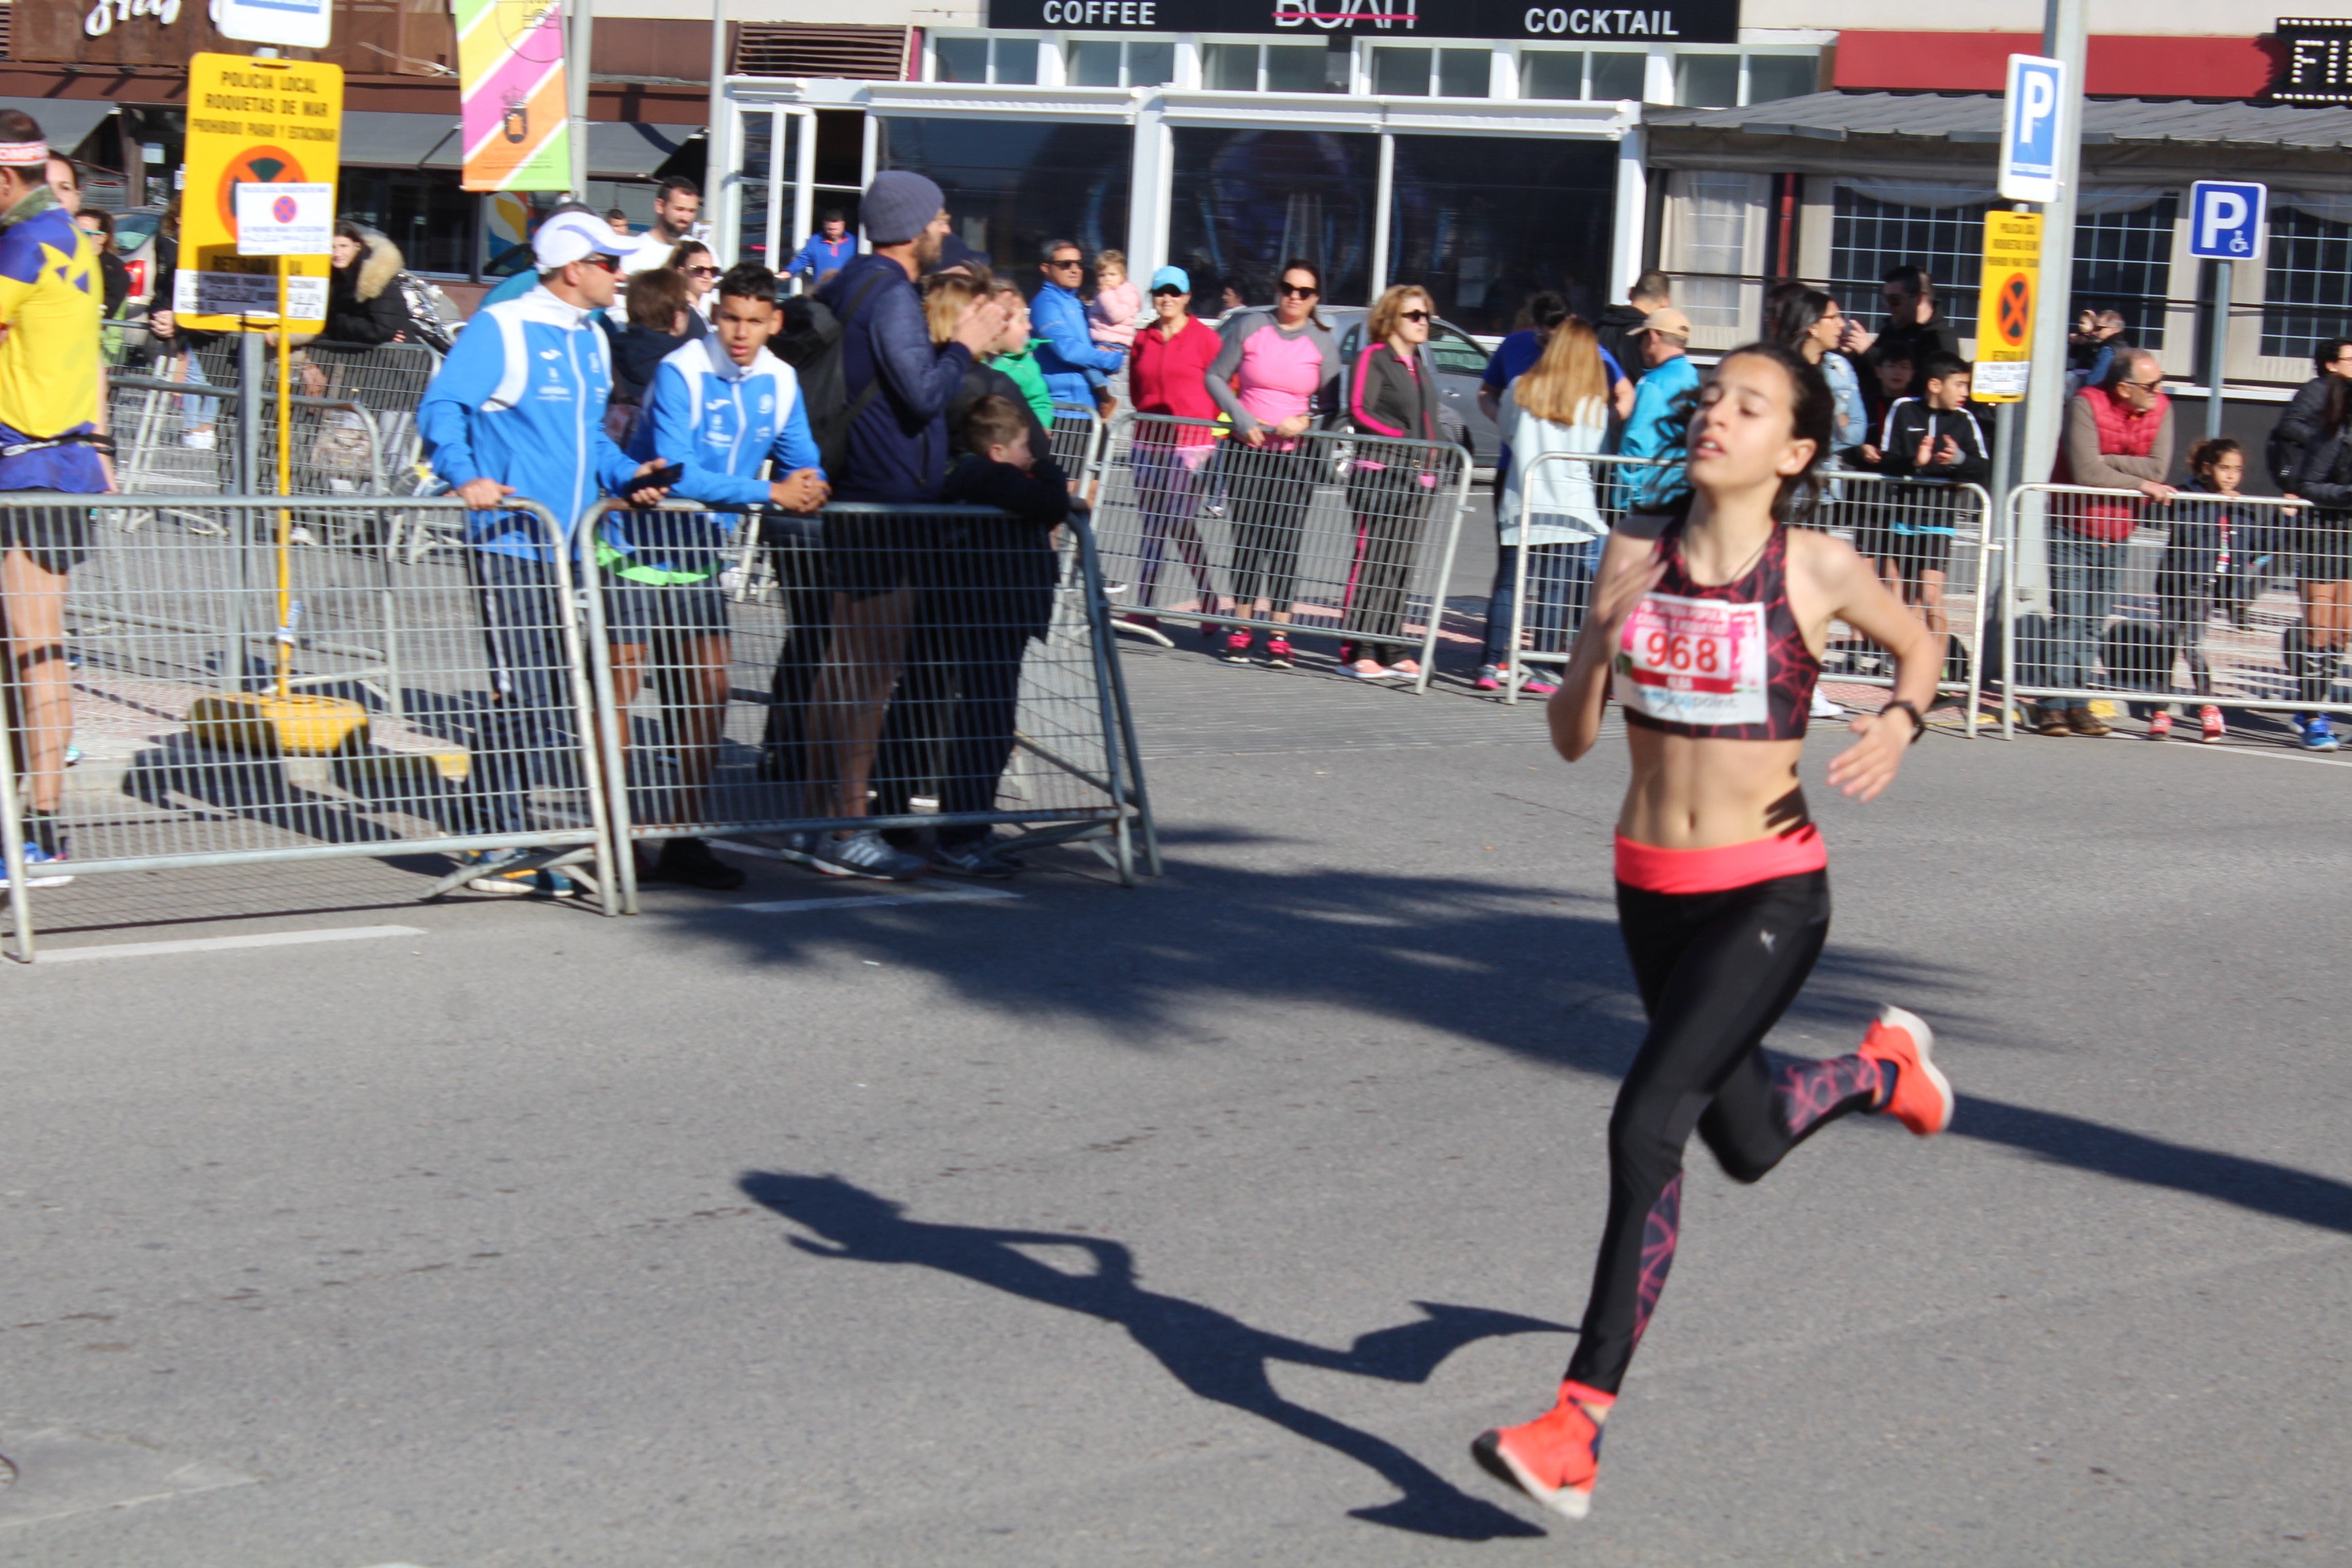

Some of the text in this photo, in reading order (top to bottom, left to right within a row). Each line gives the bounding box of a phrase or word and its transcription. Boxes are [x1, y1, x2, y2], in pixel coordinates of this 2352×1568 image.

[1043, 0, 1156, 25] COFFEE
[1524, 7, 1679, 35] COCKTAIL
[220, 71, 318, 94] POLICIA LOCAL
[204, 93, 329, 118] ROQUETAS DE MAR
[2019, 70, 2055, 144] P
[2200, 191, 2249, 249] P
[1646, 631, 1719, 673] 968
